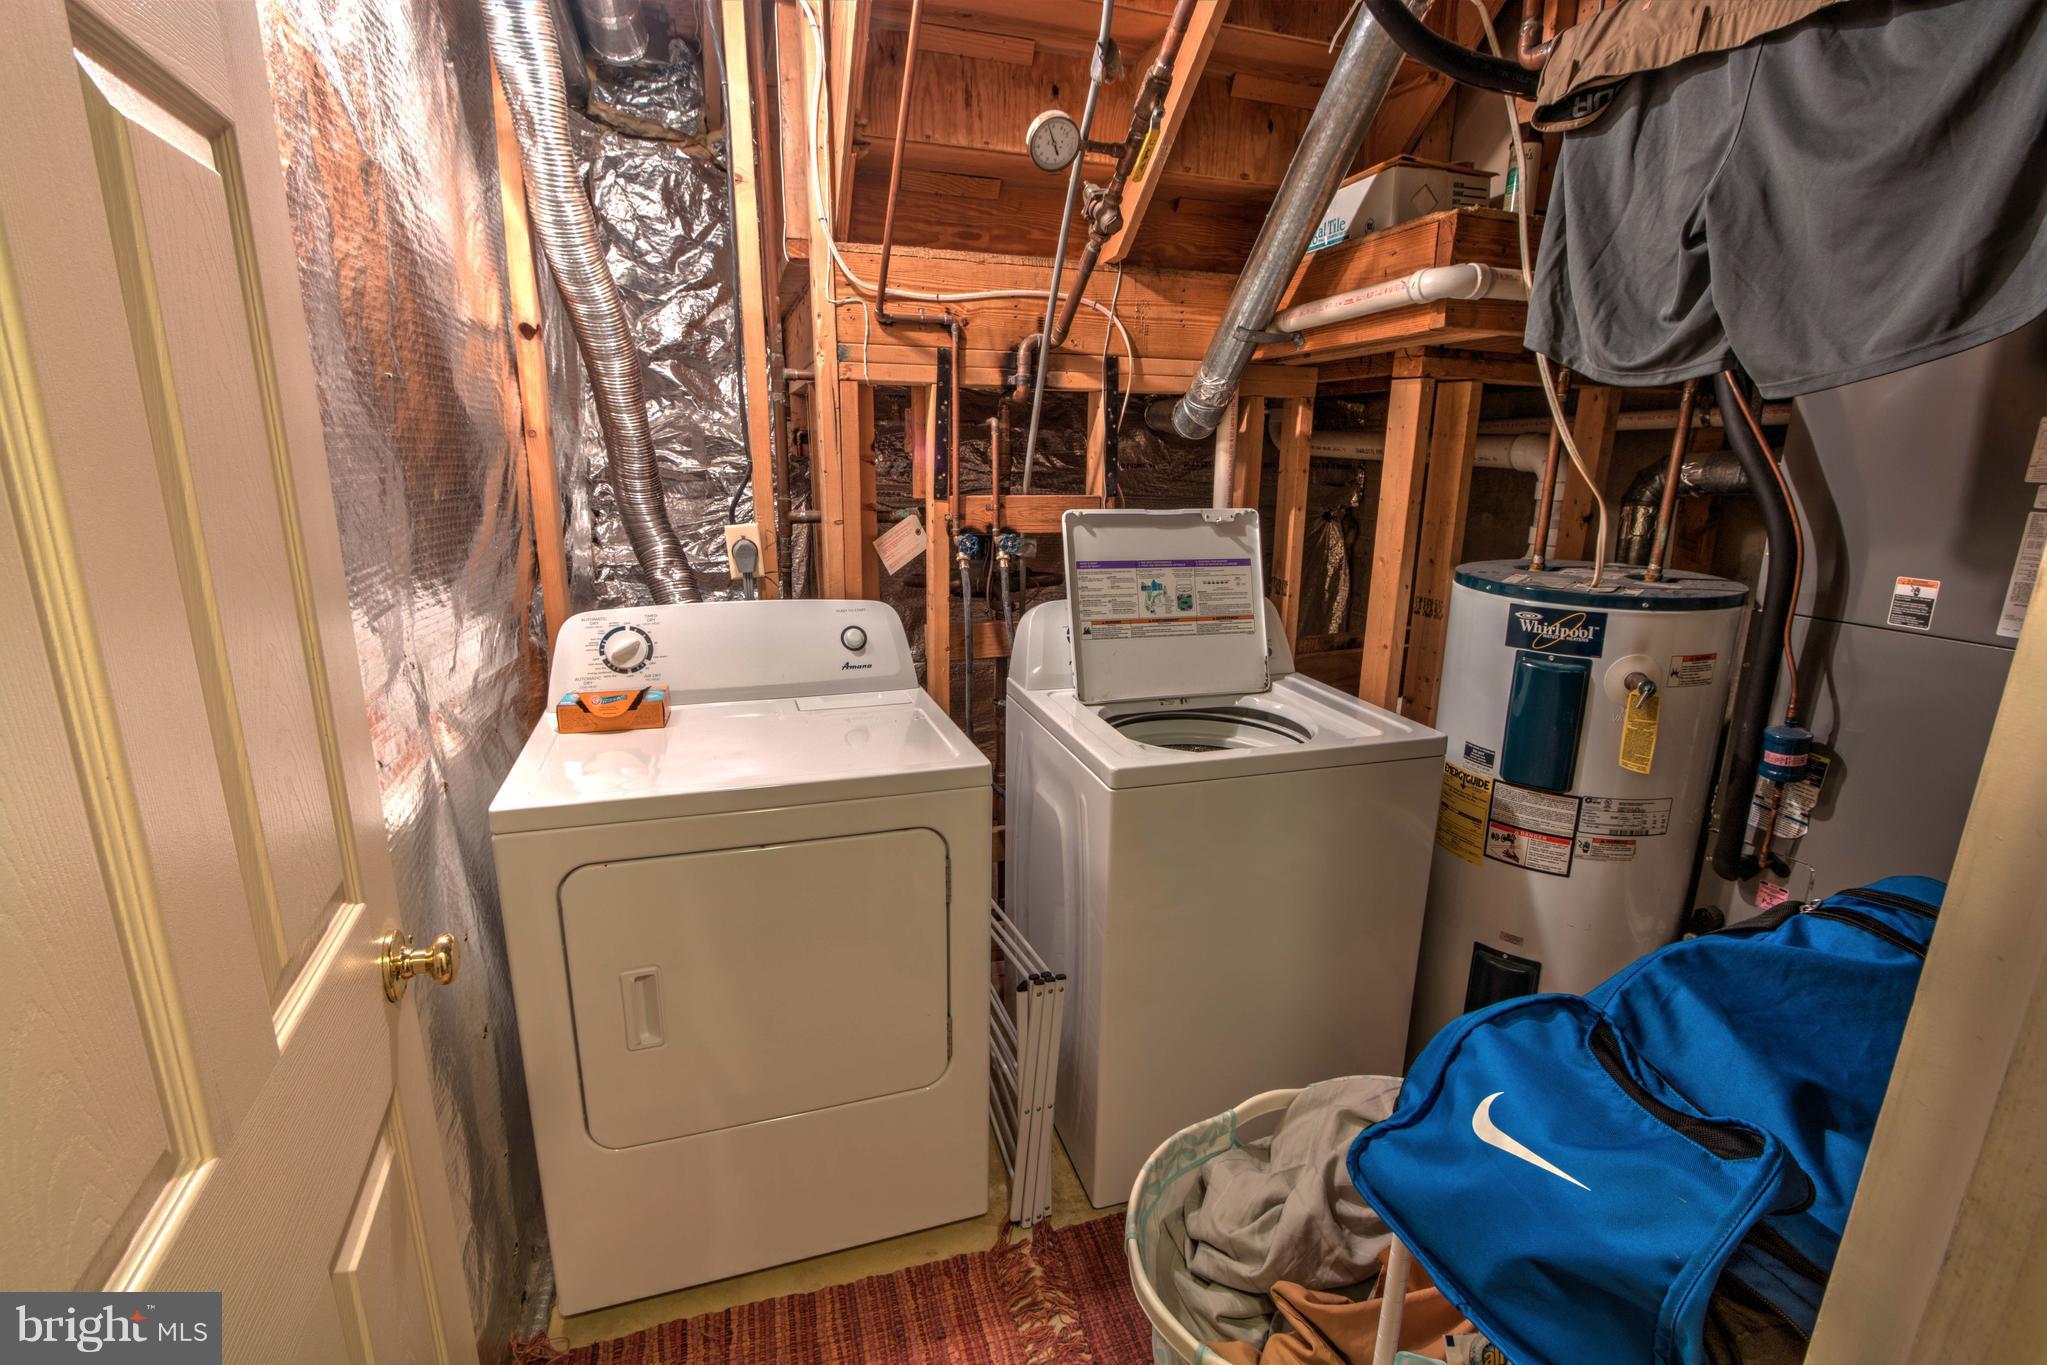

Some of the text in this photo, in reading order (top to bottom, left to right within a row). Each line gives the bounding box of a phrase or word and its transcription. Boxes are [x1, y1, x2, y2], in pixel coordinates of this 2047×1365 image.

[1328, 217, 1346, 235] Tile
[1519, 618, 1593, 640] Whirlpool
[841, 661, 872, 671] Amana
